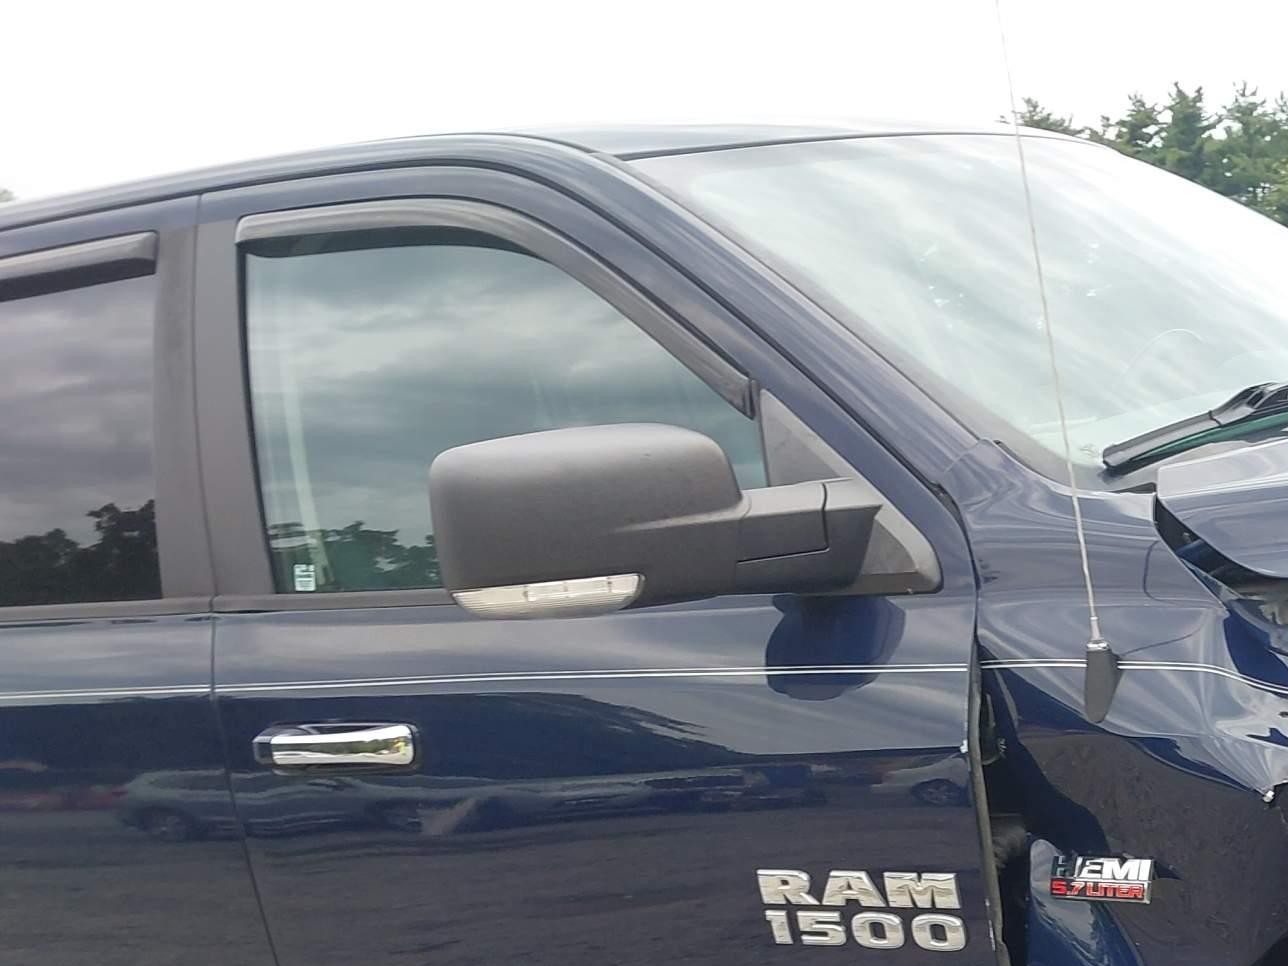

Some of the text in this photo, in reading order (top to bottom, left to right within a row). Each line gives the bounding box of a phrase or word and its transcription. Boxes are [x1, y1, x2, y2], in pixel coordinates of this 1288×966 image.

[1051, 855, 1153, 881] HEMI
[756, 869, 961, 909] RAM
[1051, 880, 1145, 898] 5.7 LITER
[764, 909, 968, 952] 1500
